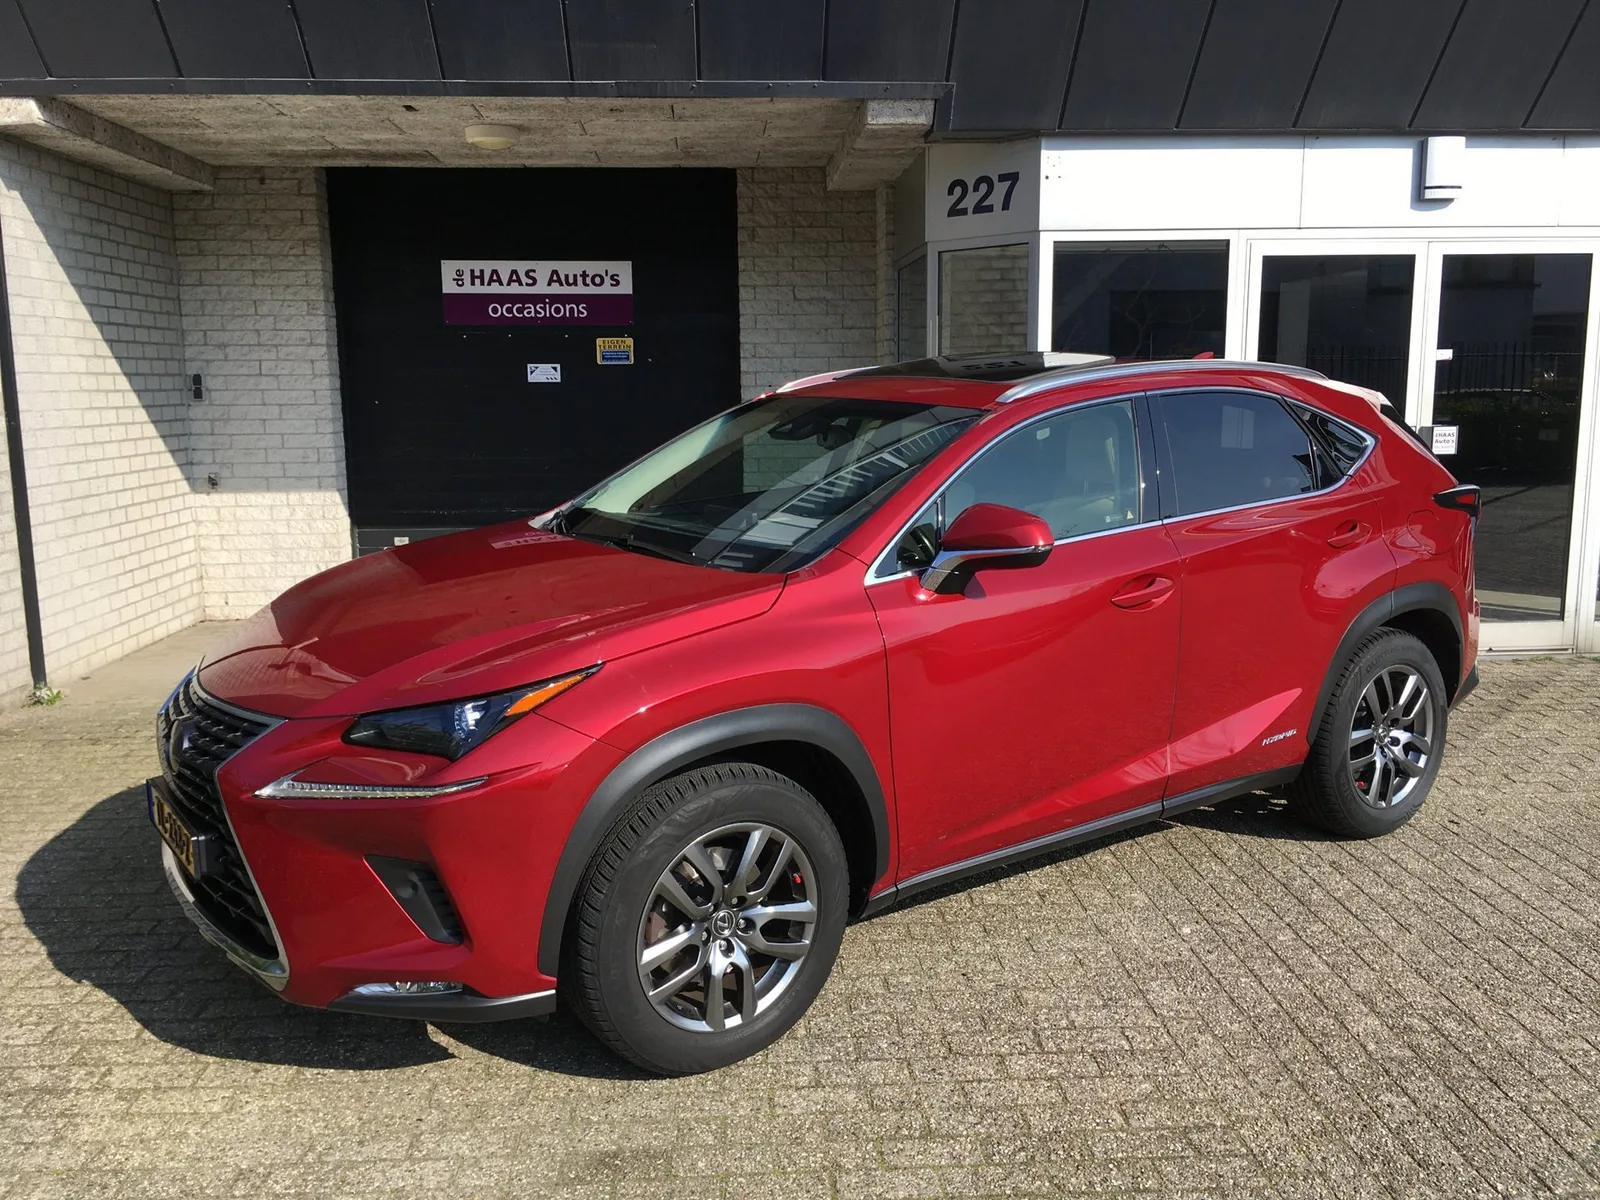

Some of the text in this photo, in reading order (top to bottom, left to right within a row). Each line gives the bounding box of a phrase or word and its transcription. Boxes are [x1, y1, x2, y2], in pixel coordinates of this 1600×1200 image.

[946, 171, 1020, 218] 227
[452, 268, 621, 288] de HAAS Auto's
[488, 298, 588, 318] occasions
